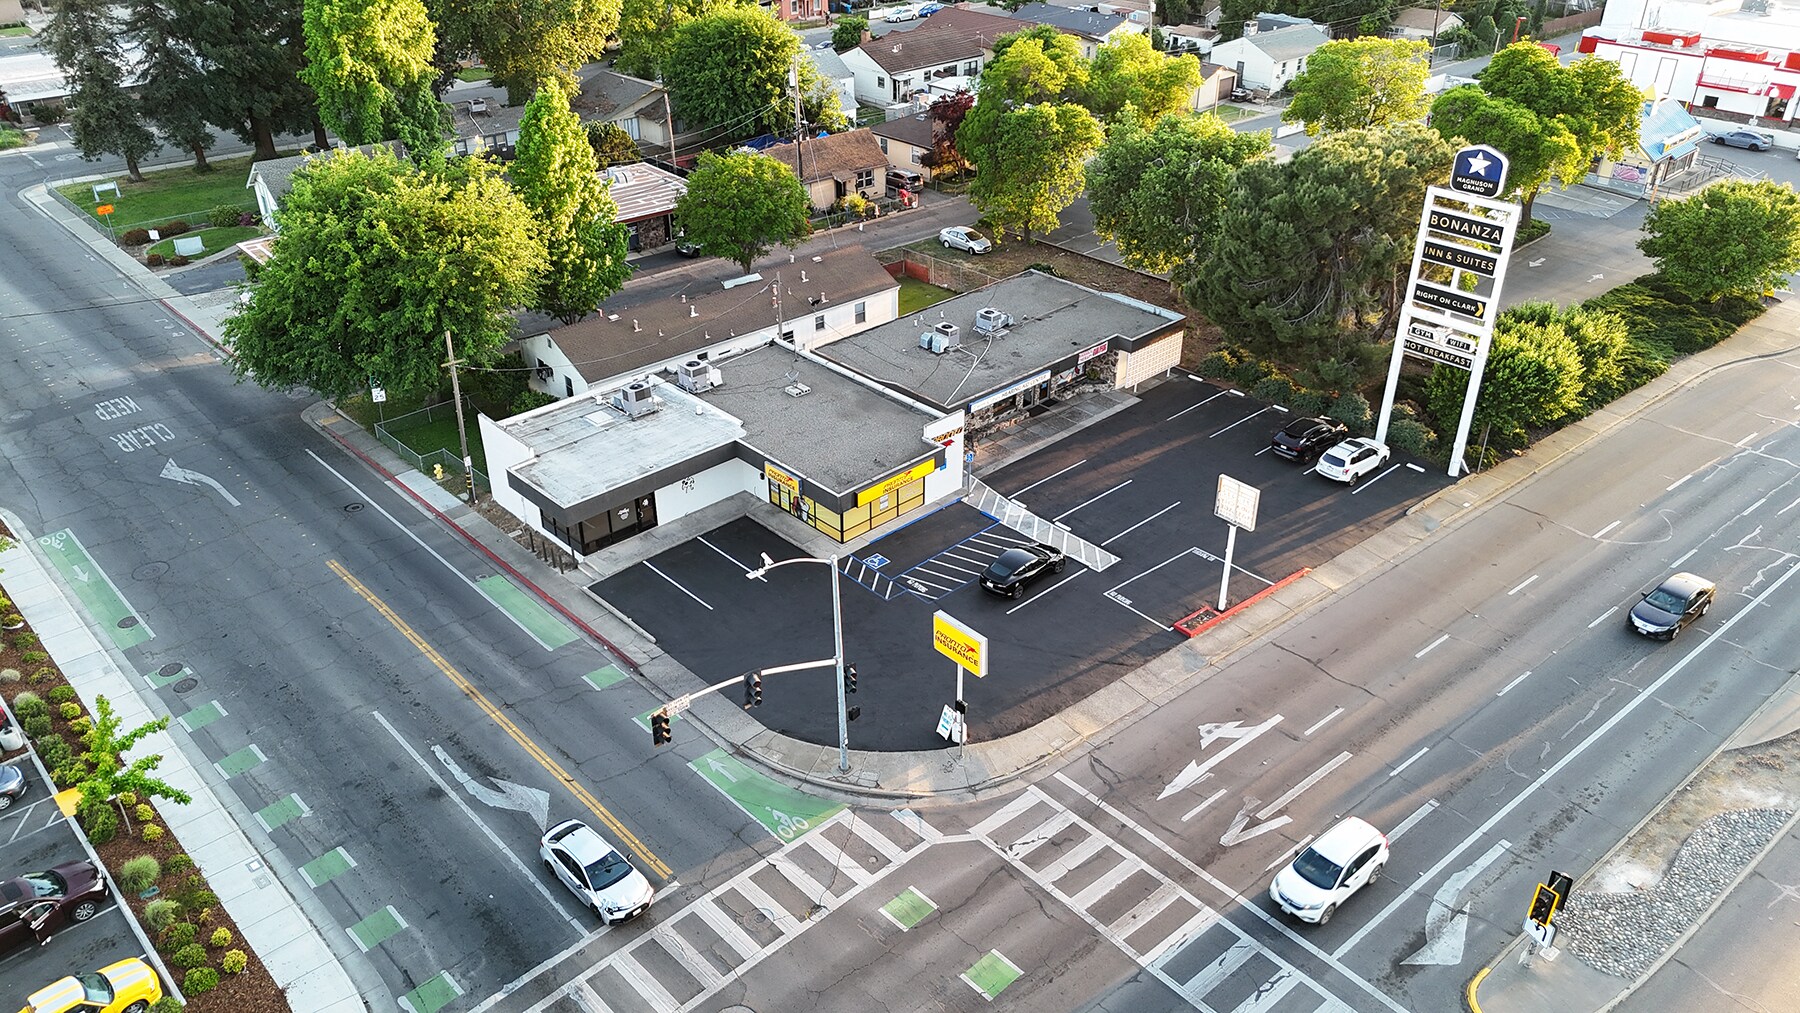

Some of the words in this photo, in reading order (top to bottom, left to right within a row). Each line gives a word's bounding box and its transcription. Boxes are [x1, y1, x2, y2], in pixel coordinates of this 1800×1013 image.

[1456, 176, 1494, 189] MAGNUSON
[1462, 183, 1485, 193] GRAND
[1430, 214, 1500, 241] BONANZA
[1424, 246, 1444, 258] INN
[1445, 251, 1453, 260] &
[1456, 254, 1494, 271] SUITES
[1416, 289, 1438, 301] RIGHT
[1440, 297, 1450, 305] ON
[1452, 300, 1476, 312] CLARK
[1414, 328, 1432, 338] GYM
[1450, 339, 1467, 349] WIFI
[1404, 341, 1422, 351] HOT
[1423, 346, 1471, 367] BREAKFAST
[95, 396, 142, 420] KEEP
[109, 423, 175, 453] CLEAR
[935, 635, 979, 667] INSURANCE
[936, 630, 967, 652] PRONTO
